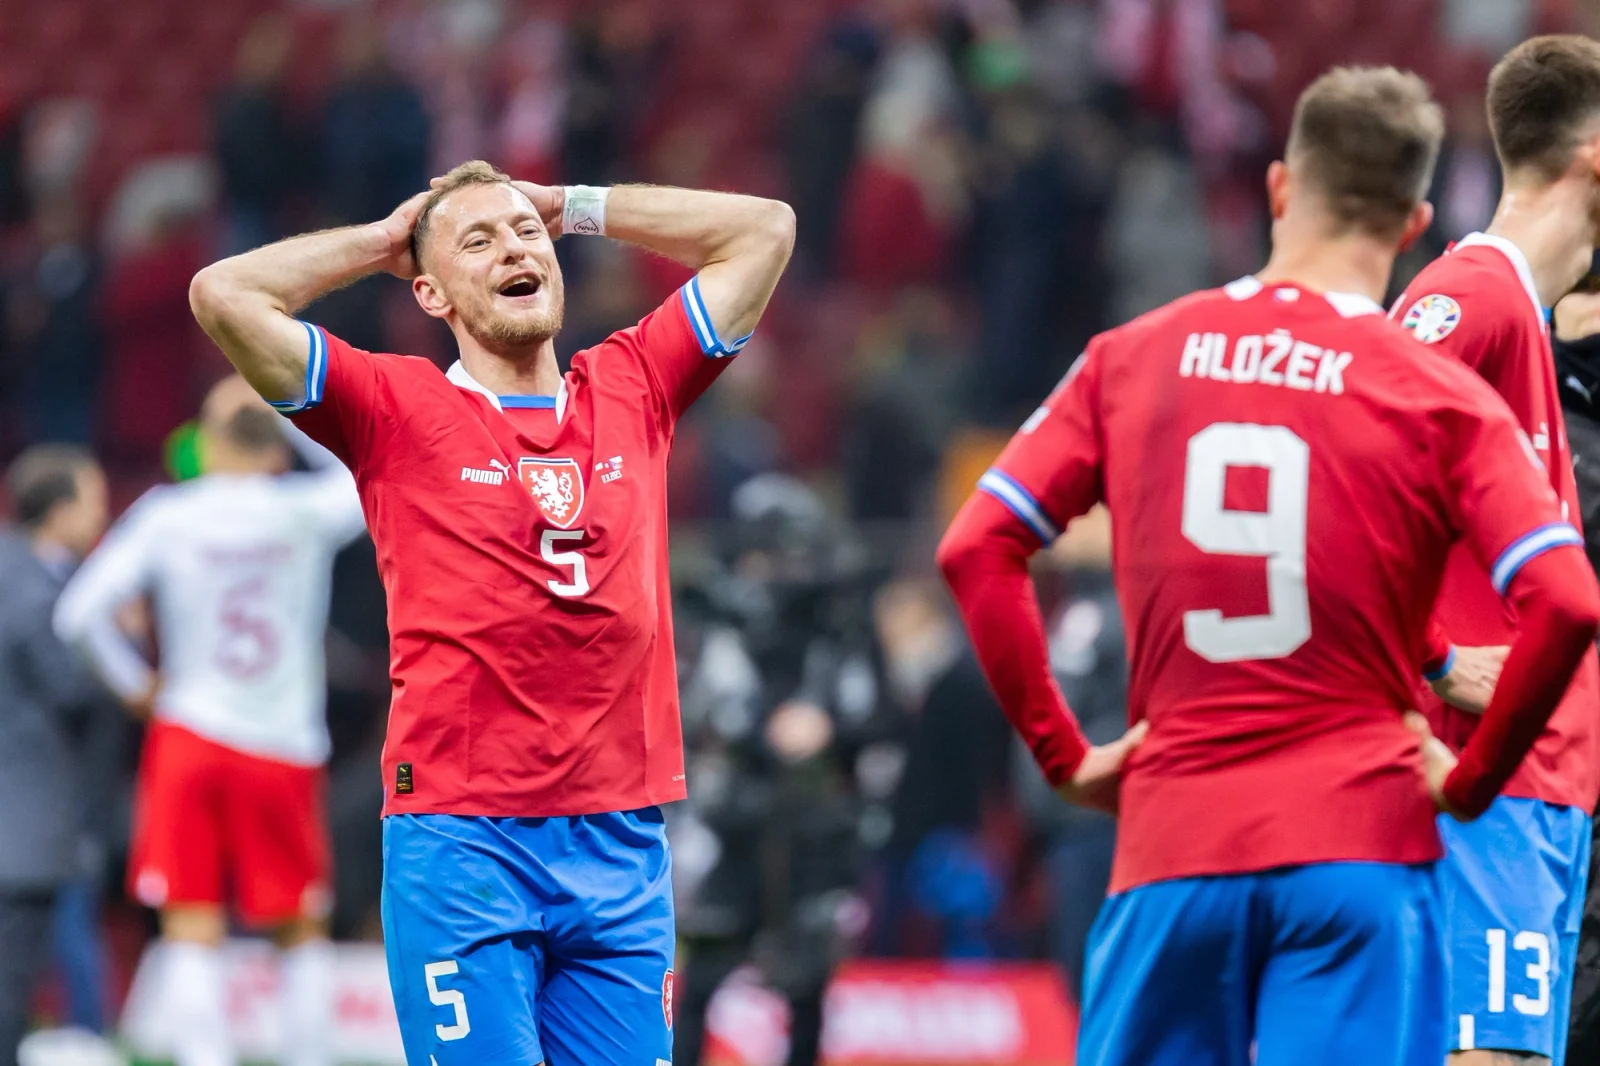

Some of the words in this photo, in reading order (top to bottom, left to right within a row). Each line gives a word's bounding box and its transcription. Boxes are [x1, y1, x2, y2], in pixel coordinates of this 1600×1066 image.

[1180, 329, 1352, 395] HLOŽEK
[461, 467, 503, 485] PUMA
[540, 529, 590, 596] 5
[1181, 422, 1312, 664] 9
[424, 960, 471, 1042] 5
[1486, 928, 1550, 1016] 13
